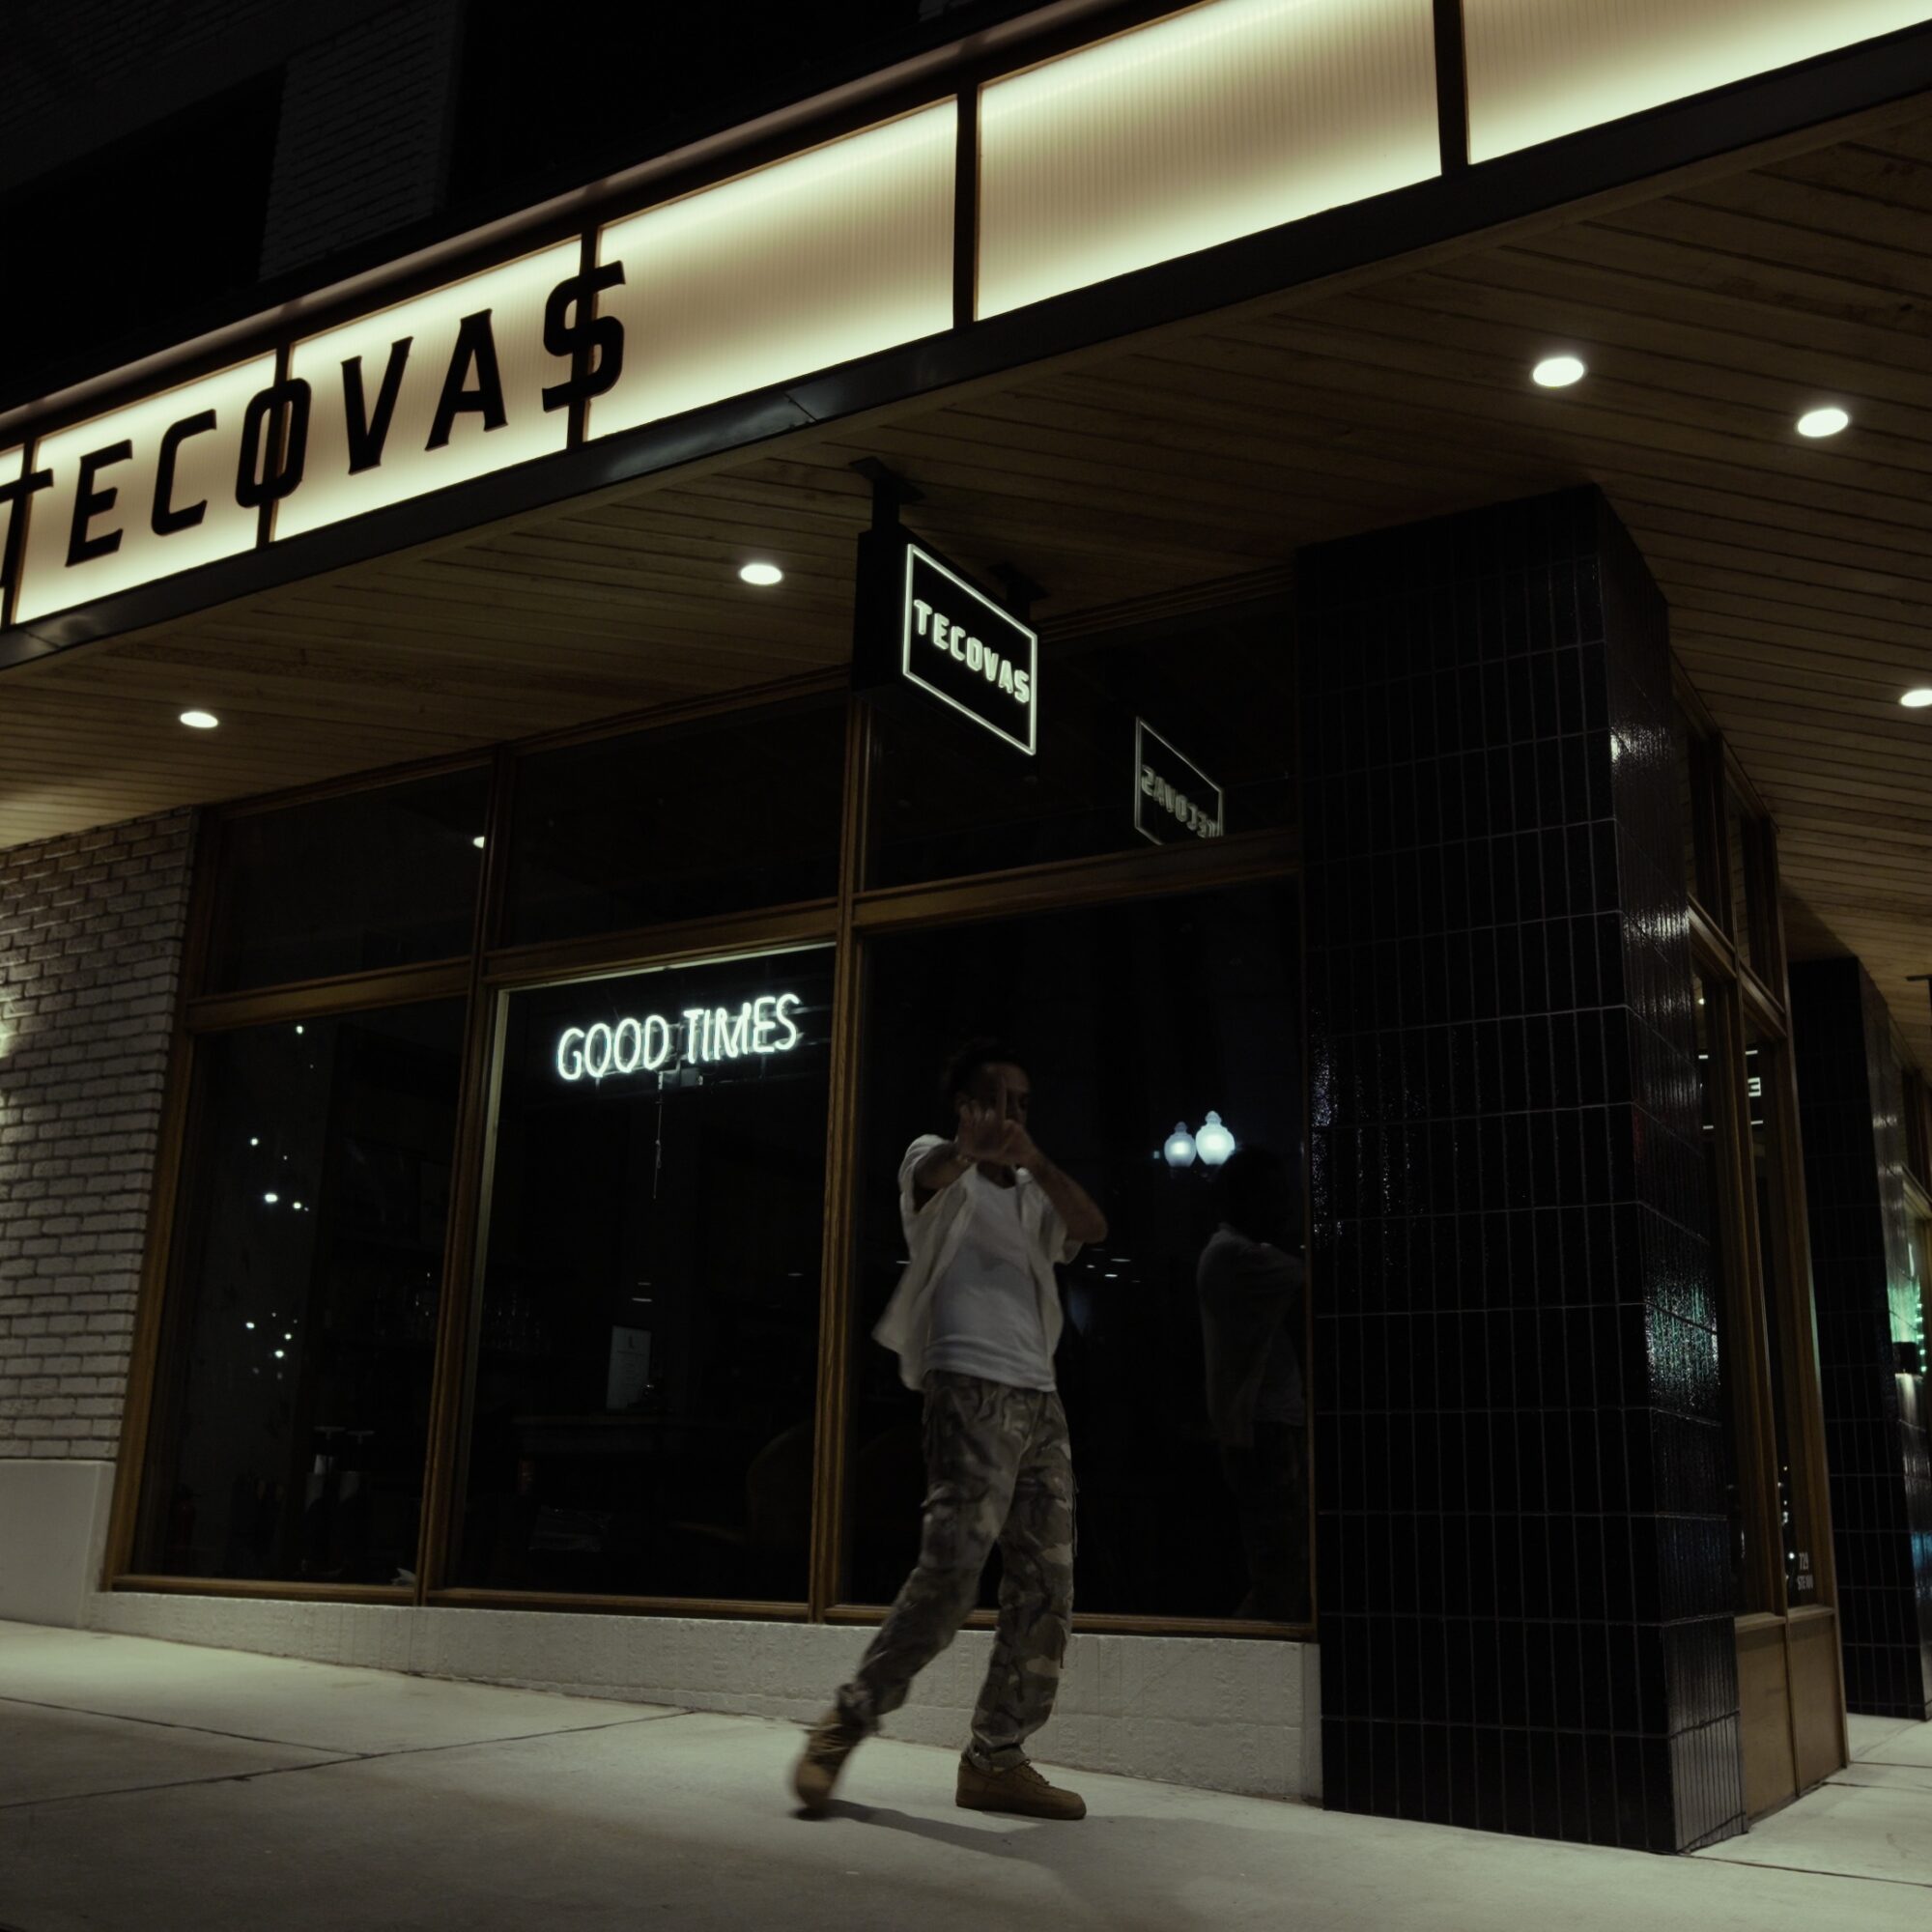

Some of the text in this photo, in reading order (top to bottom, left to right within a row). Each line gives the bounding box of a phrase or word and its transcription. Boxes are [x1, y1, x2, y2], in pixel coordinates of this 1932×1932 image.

[0, 261, 625, 587] TECOVAS
[914, 599, 1030, 704] TECOVAS
[556, 993, 802, 1080] GOOD TIMES
